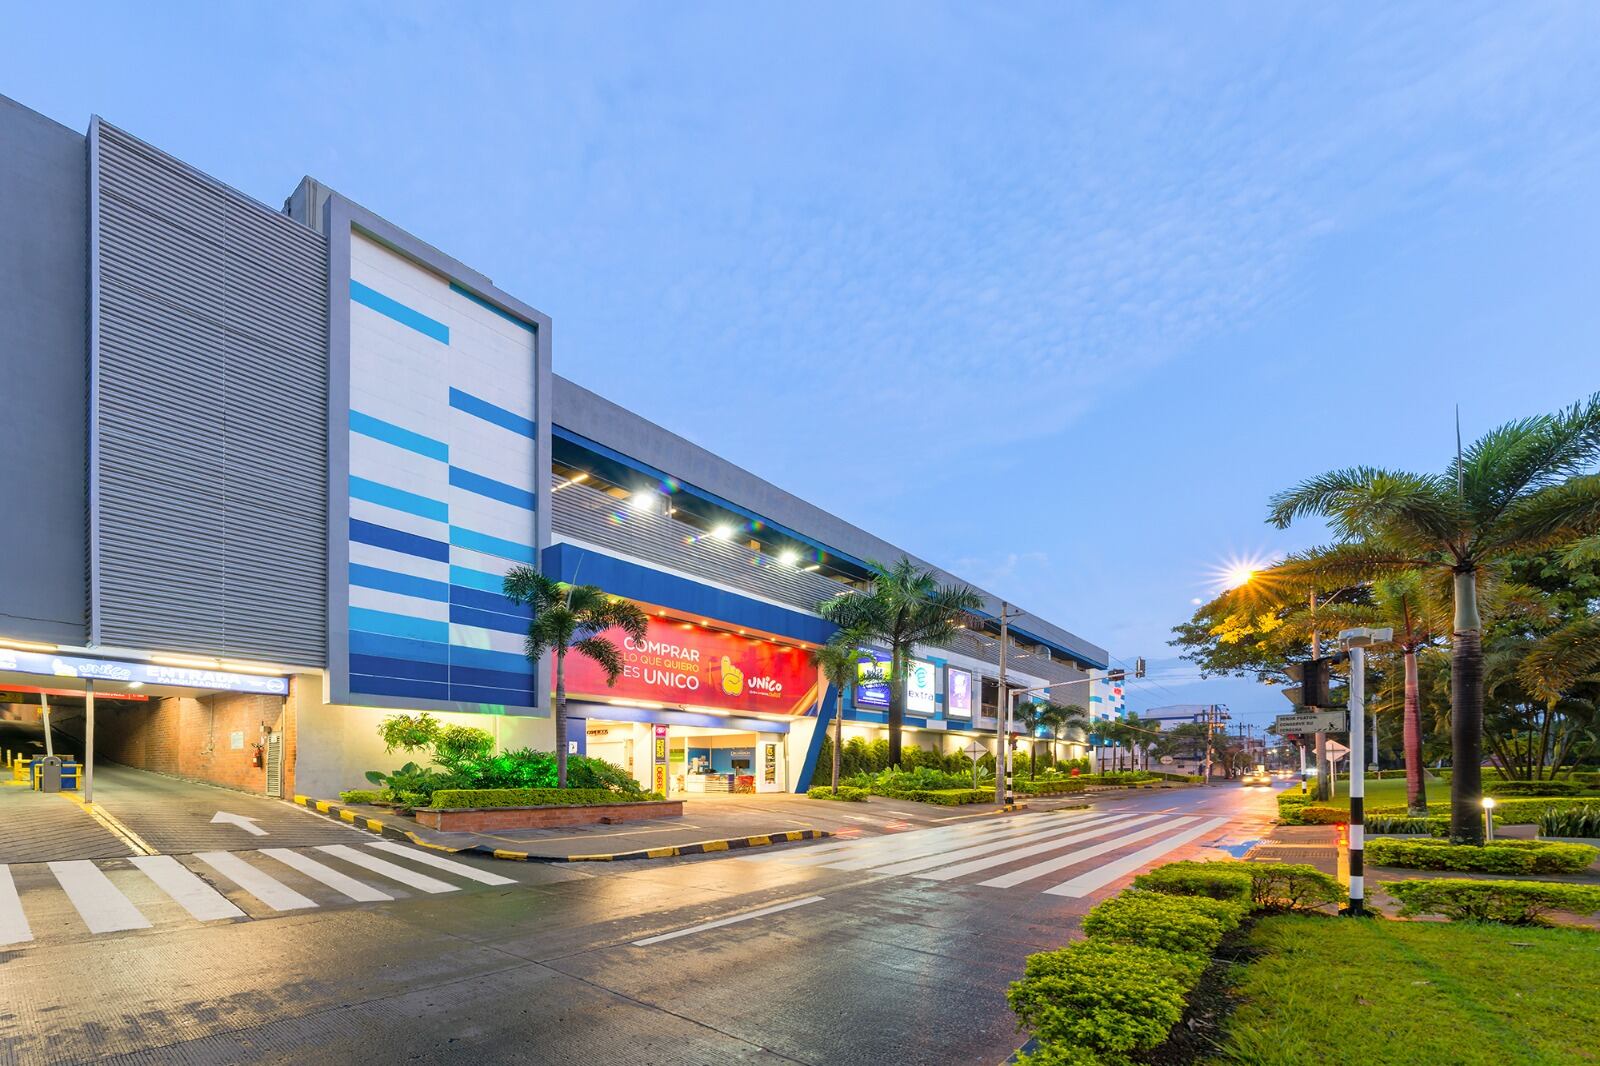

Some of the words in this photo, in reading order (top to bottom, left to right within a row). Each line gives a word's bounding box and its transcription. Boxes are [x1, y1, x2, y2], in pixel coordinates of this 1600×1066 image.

[624, 637, 700, 662] COMPRAR
[624, 653, 638, 662] LO
[641, 655, 662, 667] QUE
[664, 660, 700, 672] QUIERO
[146, 665, 241, 684] ENTRADA
[157, 677, 232, 689] PARQUEADERO
[624, 665, 640, 678] ES
[644, 668, 699, 690] UNICO
